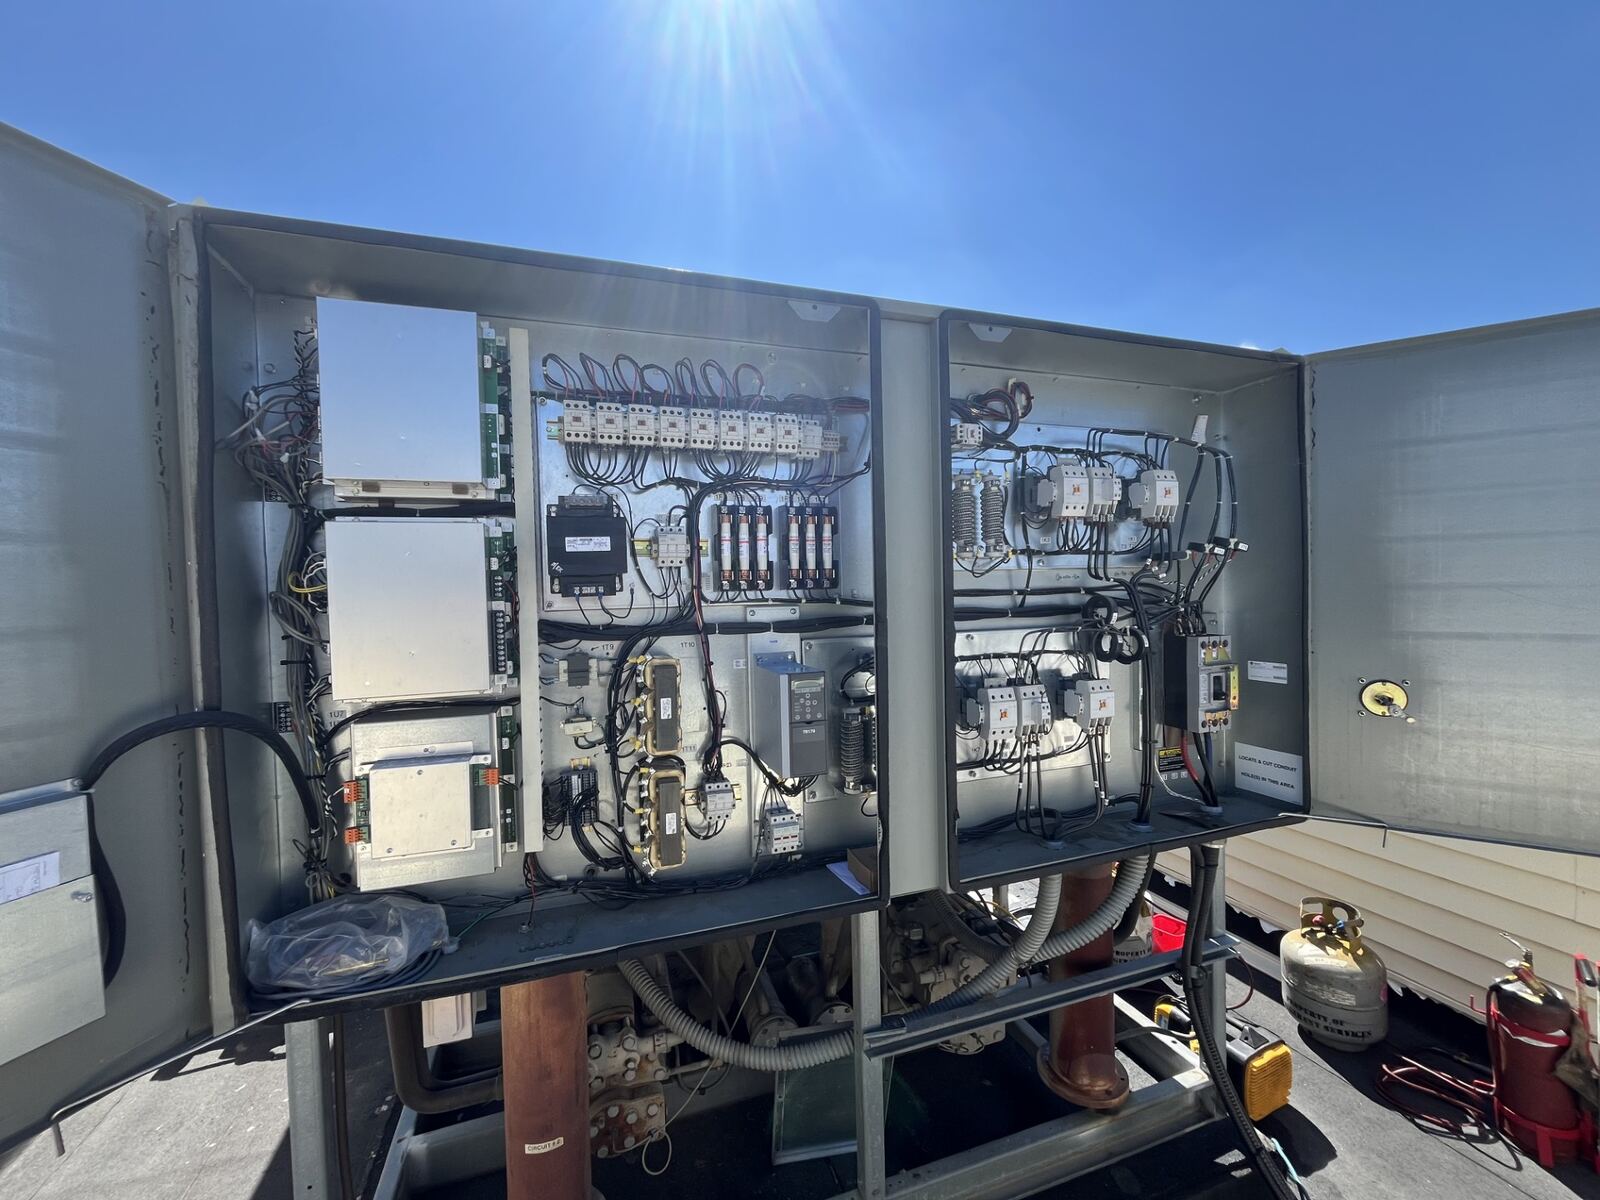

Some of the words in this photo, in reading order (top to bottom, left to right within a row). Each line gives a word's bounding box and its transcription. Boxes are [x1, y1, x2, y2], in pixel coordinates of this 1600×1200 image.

[1238, 755, 1257, 763] LOCATE
[1273, 763, 1297, 772] CONDUIT
[1280, 781, 1295, 789] AREA
[1323, 1025, 1372, 1038] SERVICES
[527, 1143, 551, 1151] CIRCUIT
